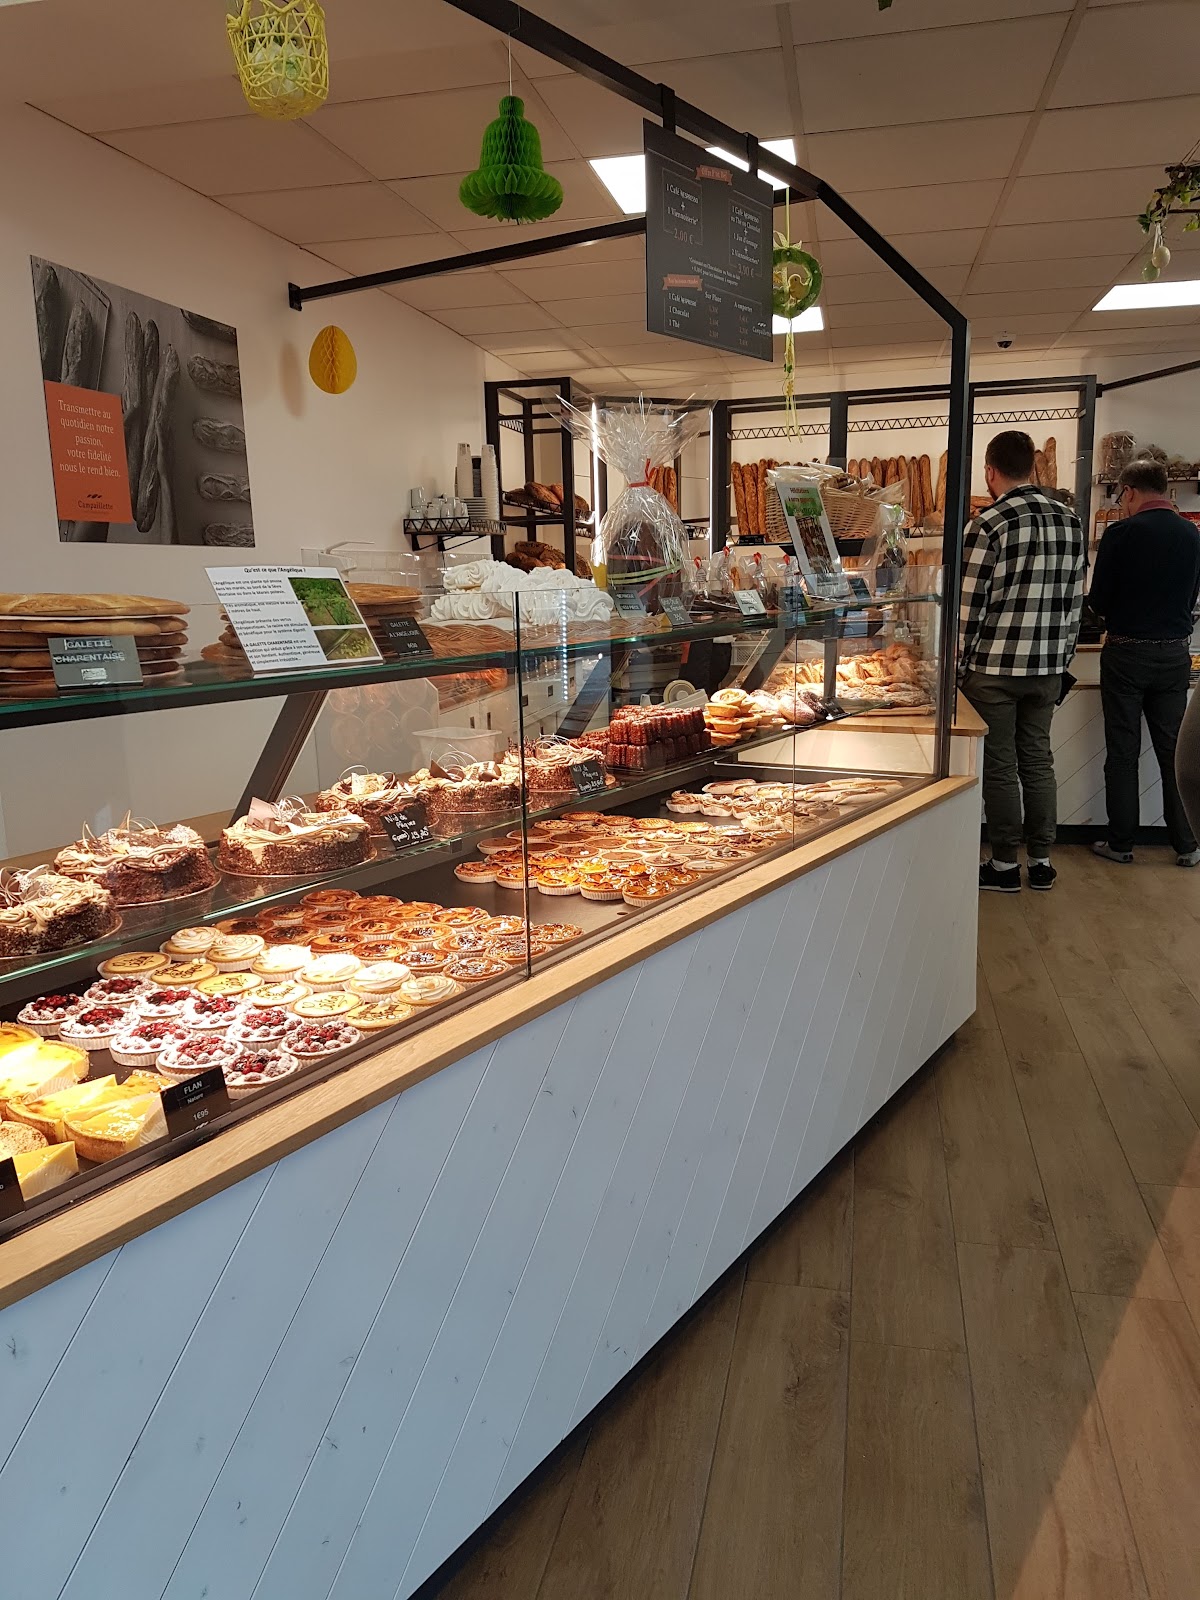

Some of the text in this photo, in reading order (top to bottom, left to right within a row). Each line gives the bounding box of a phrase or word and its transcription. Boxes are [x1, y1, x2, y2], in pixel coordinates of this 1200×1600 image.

[670, 184, 680, 196] Café
[672, 293, 681, 303] Café
[672, 306, 690, 318] Chocolat
[58, 399, 111, 419] Transmettre au
[60, 418, 114, 434] quotidien notre
[75, 435, 104, 447] passion,
[67, 449, 85, 459] votre
[60, 463, 121, 477] nous le rend bien.
[78, 501, 113, 510] Campaillette
[67, 640, 111, 648] GALETTE
[54, 651, 125, 663] CHARENTAISE
[384, 814, 399, 824] Nid
[184, 1080, 202, 1094] FLAN
[187, 1093, 204, 1104] Nature
[193, 1108, 209, 1120] 1€95
